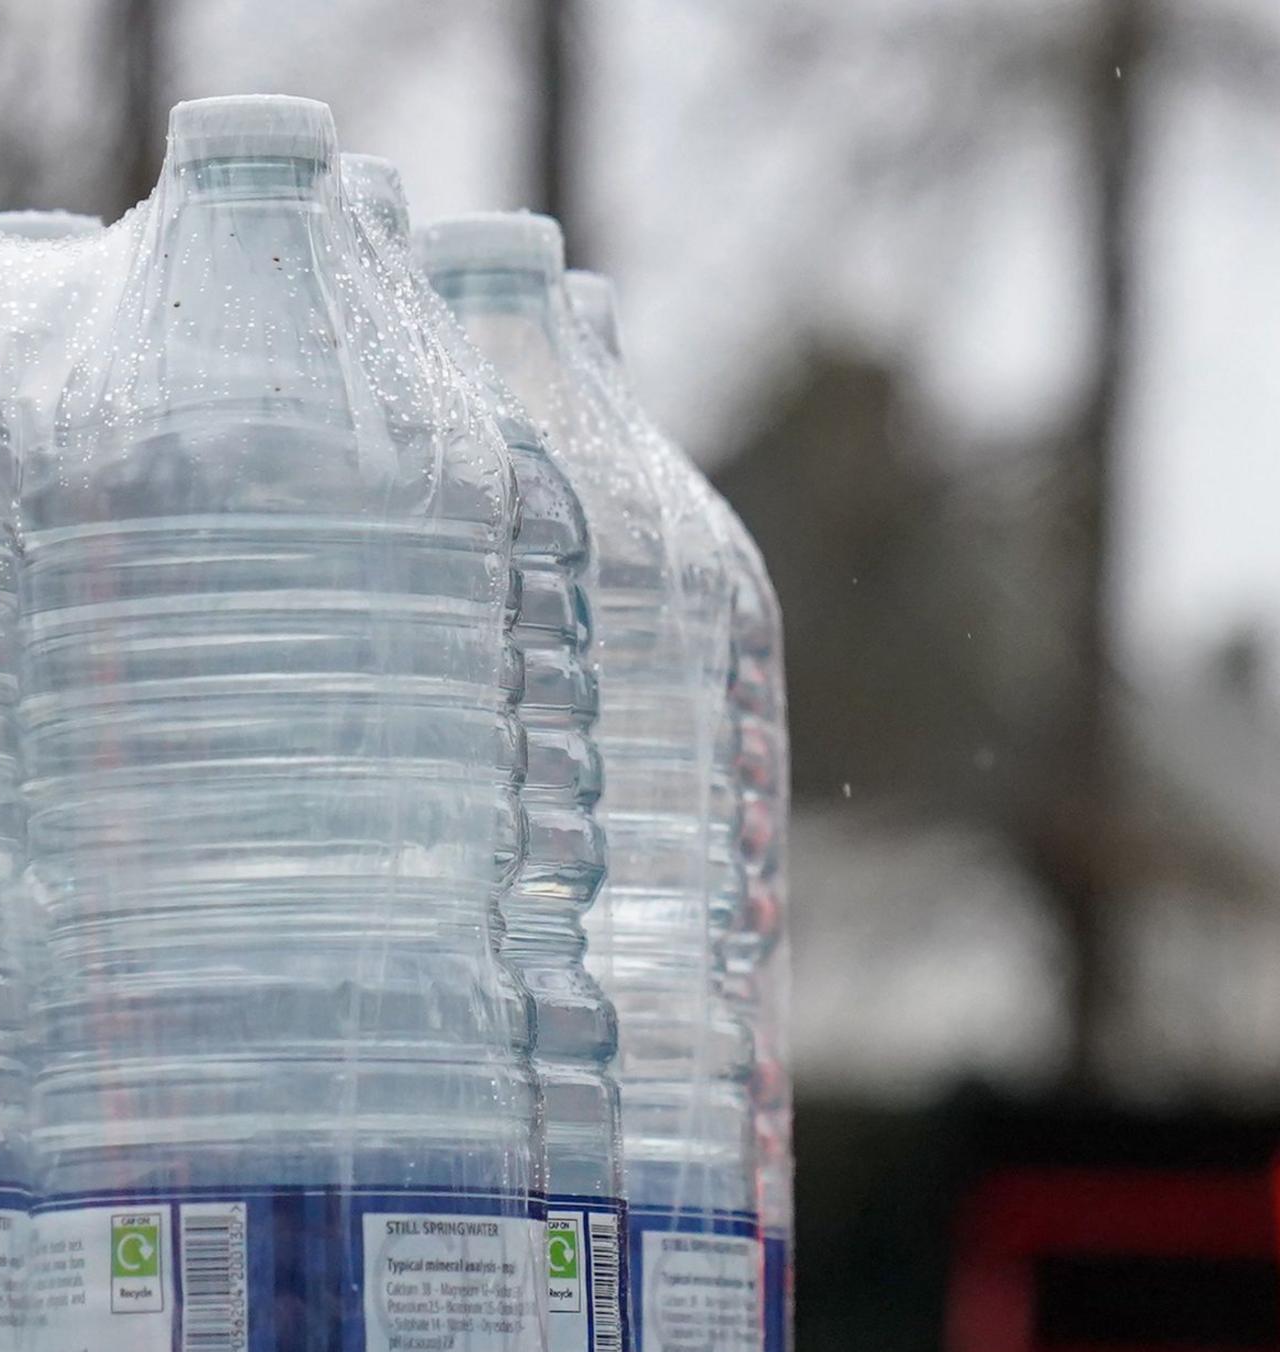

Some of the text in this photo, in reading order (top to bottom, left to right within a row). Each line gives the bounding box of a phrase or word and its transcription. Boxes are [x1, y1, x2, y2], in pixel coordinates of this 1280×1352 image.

[386, 1221, 498, 1237] STILL SPRING WATER
[560, 1221, 570, 1231] ON
[388, 1258, 423, 1275] Typical
[425, 1258, 463, 1273] mineral
[120, 1286, 152, 1300] Recycle
[549, 1288, 573, 1302] Recycle
